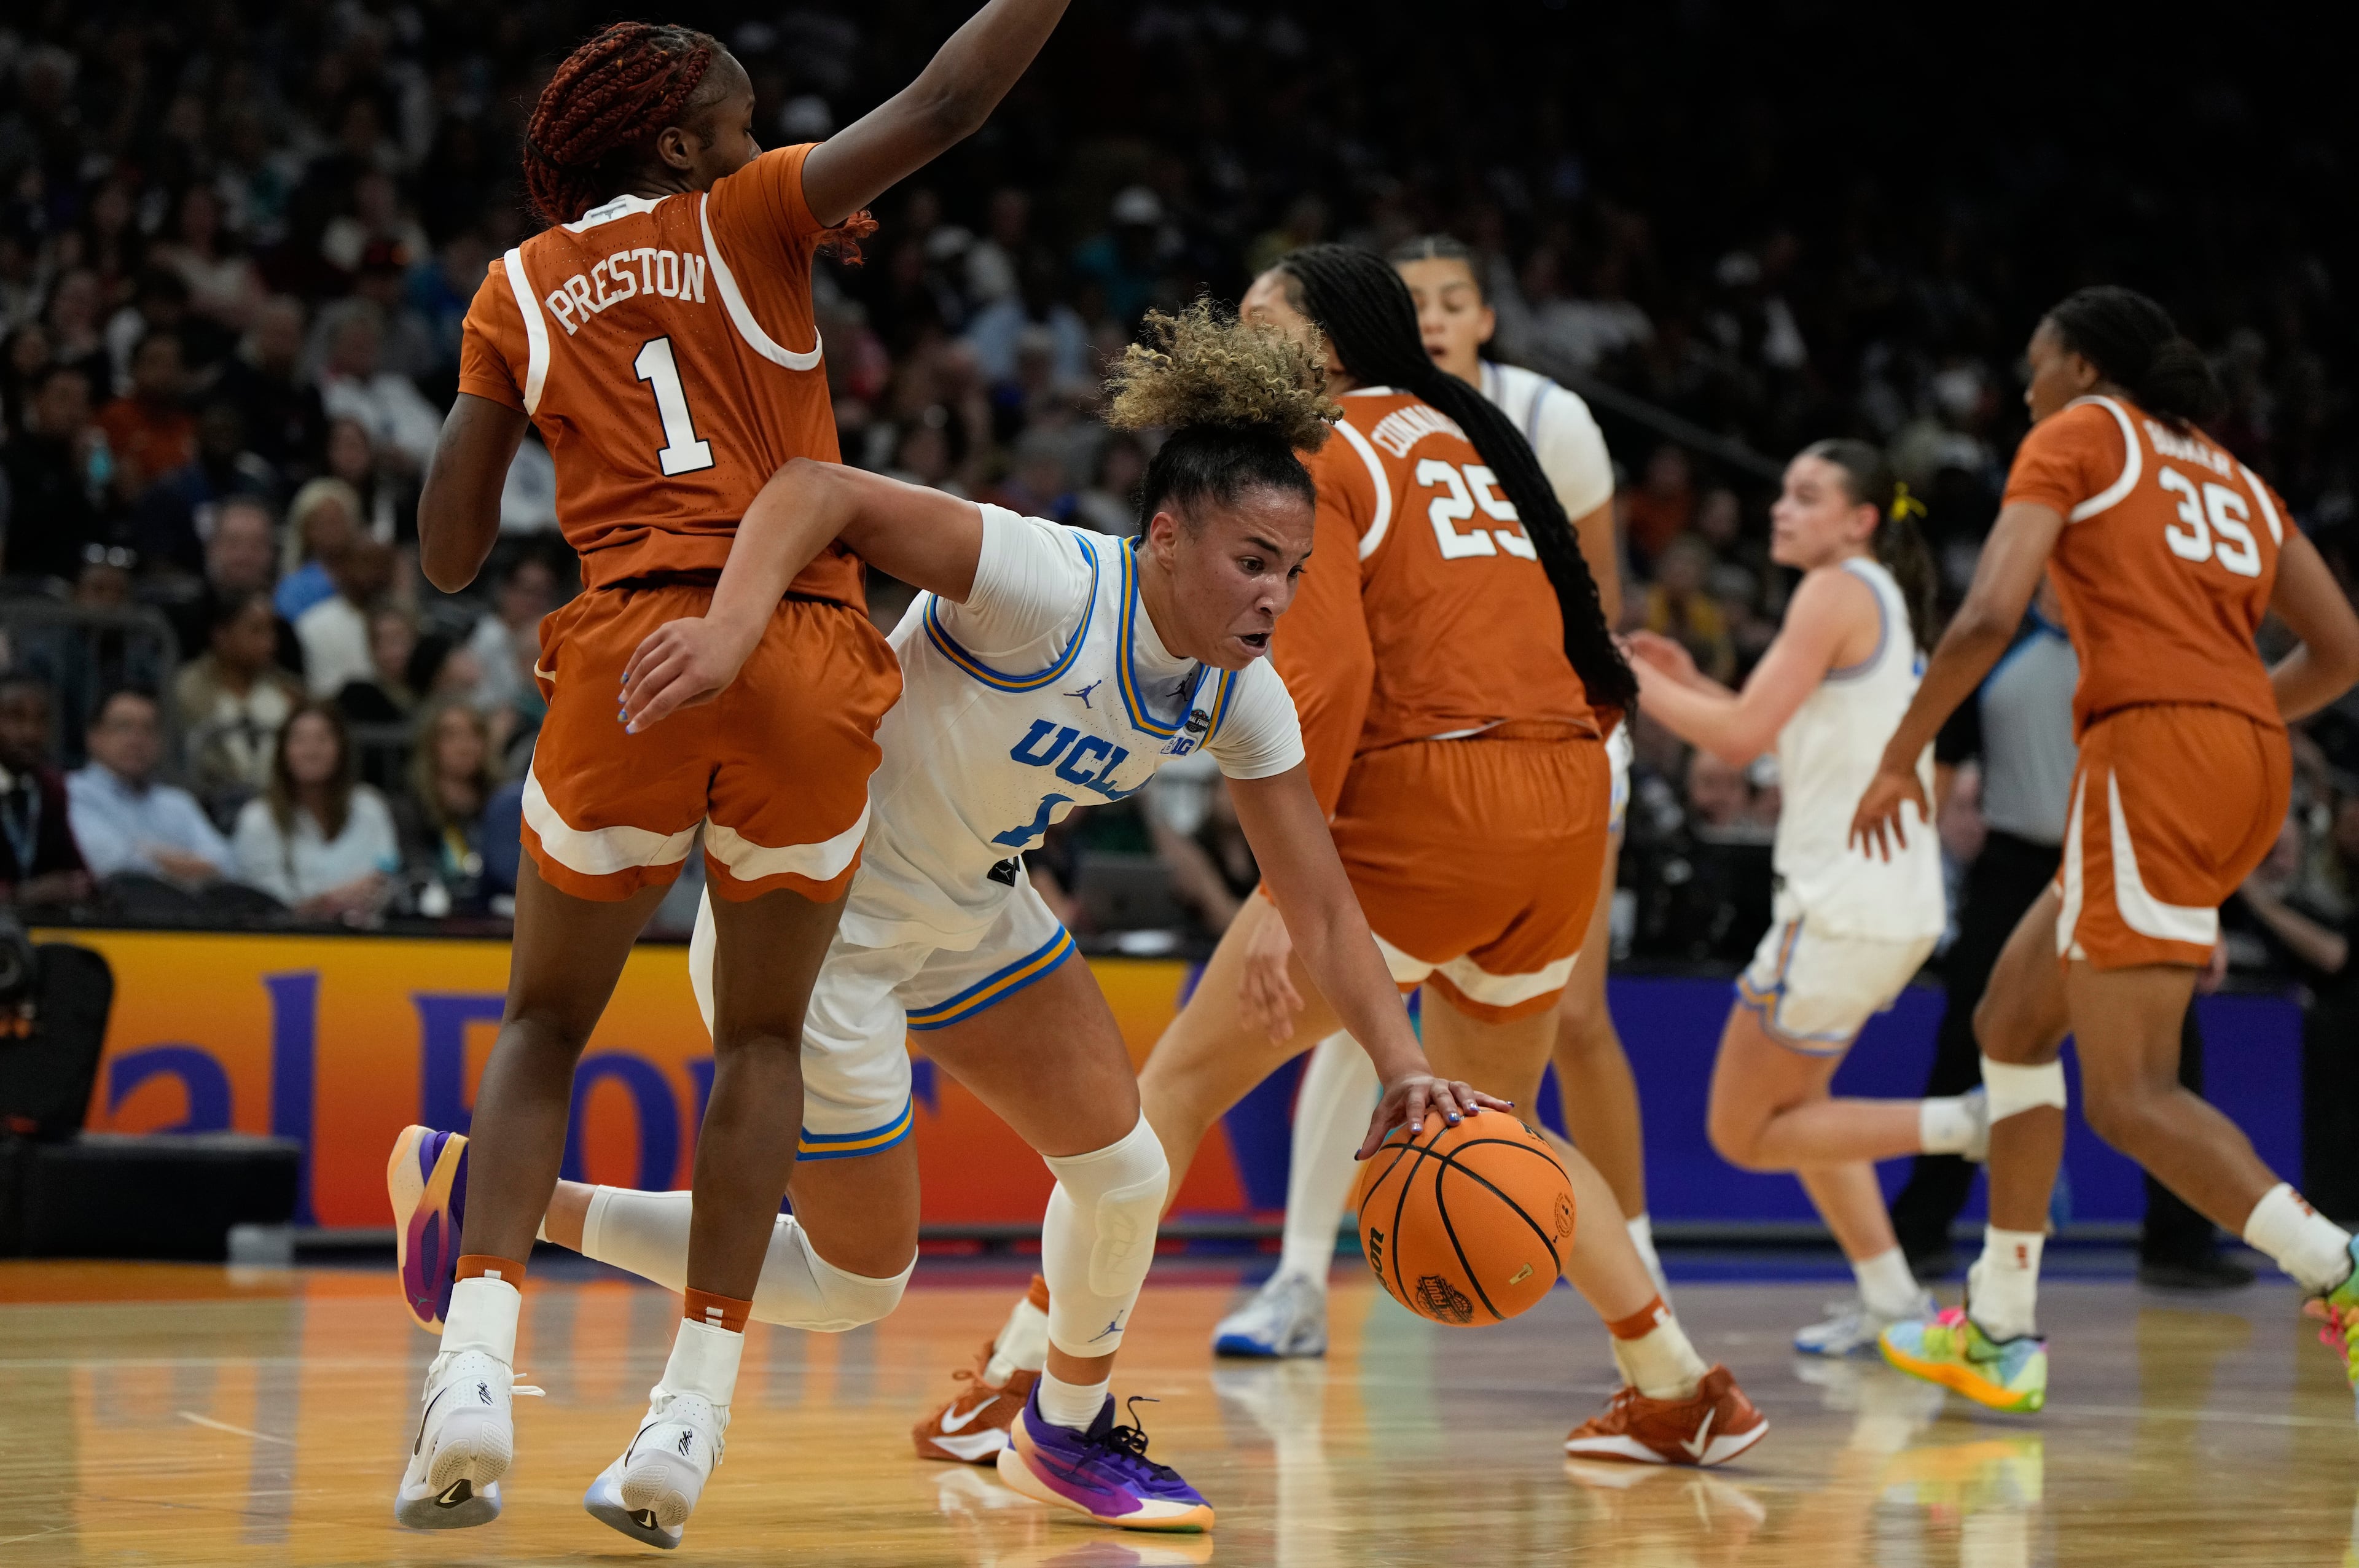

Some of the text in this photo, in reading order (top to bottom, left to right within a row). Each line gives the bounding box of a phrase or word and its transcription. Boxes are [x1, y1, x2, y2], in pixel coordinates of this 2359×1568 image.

[546, 248, 706, 336] PRESTON
[633, 335, 716, 477] 1
[1415, 458, 1537, 561] 25
[2159, 466, 2261, 577] 35
